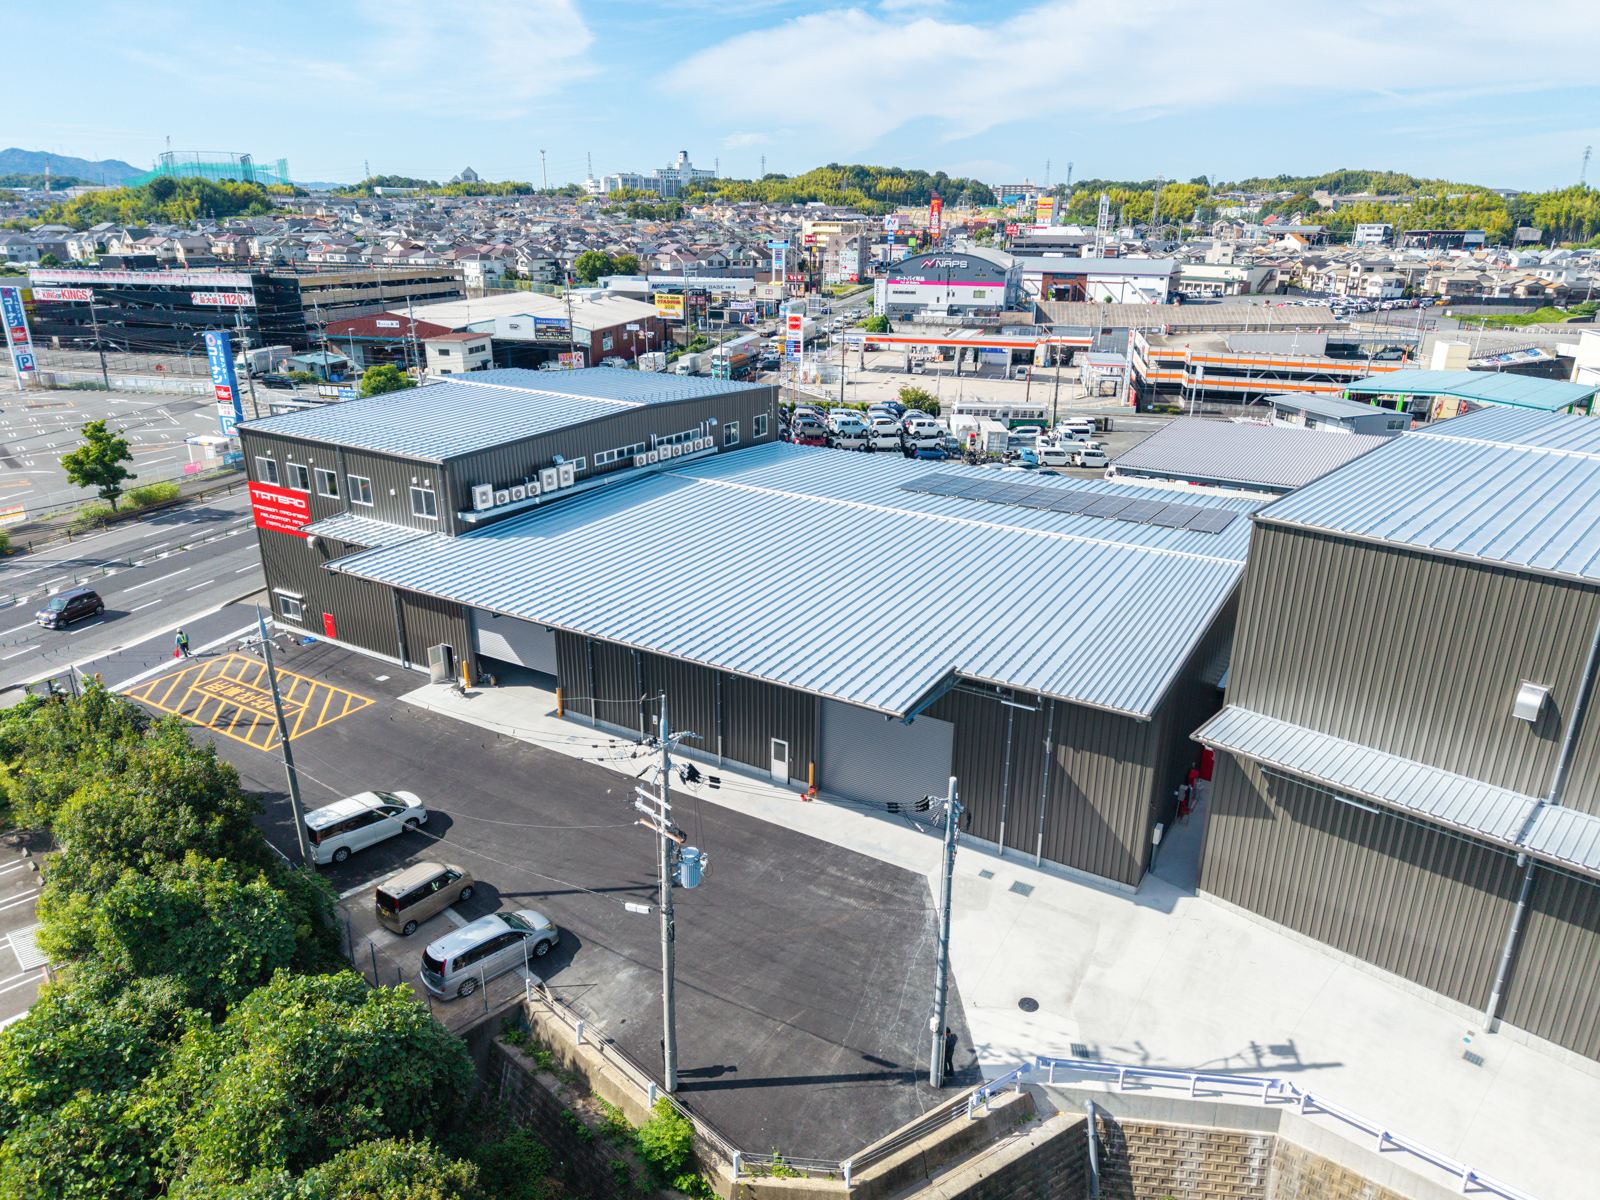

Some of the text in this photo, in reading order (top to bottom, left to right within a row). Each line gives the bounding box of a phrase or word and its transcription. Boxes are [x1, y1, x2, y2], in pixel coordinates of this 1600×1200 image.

[935, 260, 968, 268] NAPS
[61, 289, 88, 300] KINGS
[222, 293, 244, 305] 1120
[4, 297, 18, 327] コーナン
[21, 356, 30, 367] P
[207, 346, 223, 384] コーナン
[217, 339, 227, 379] ホームセンター
[225, 418, 234, 430] P
[251, 489, 306, 508] TATERO
[253, 504, 309, 520] PRECISION MACHINERY
[260, 512, 291, 523] RELOCATION
[266, 520, 298, 531] INSTALLATIO
